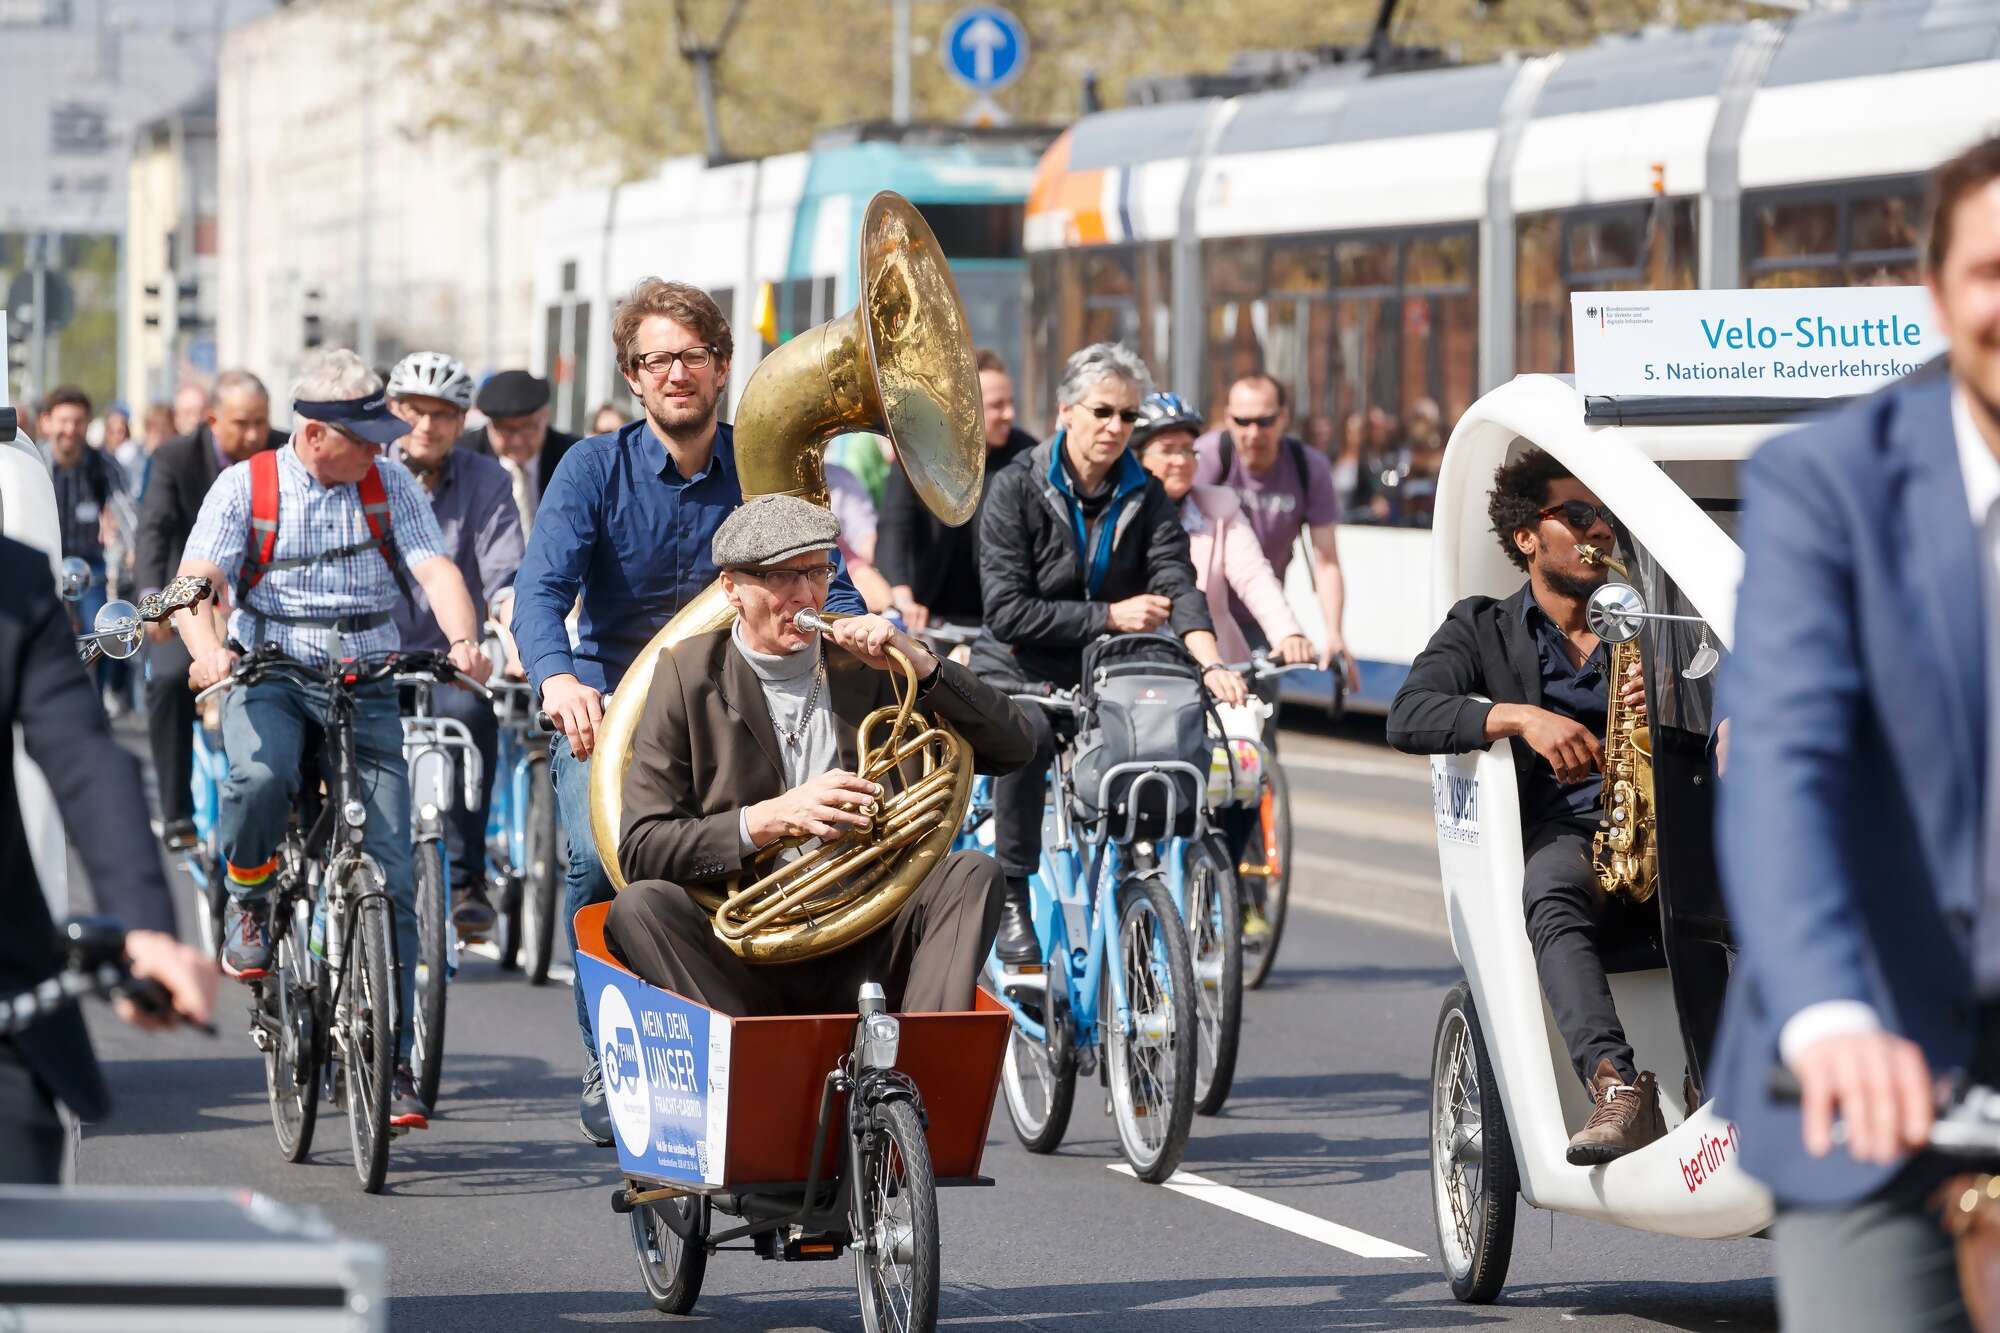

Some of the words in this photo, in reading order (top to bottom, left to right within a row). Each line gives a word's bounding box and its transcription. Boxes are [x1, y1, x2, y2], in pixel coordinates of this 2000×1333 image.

[1700, 315, 1921, 349] Velo-Shuttle
[1644, 364, 1660, 380] 5.
[1667, 361, 1766, 380] Nationaler
[640, 1010, 668, 1043] MEIN,
[666, 1012, 694, 1048] DEIN,
[646, 1046, 699, 1093] UNSER
